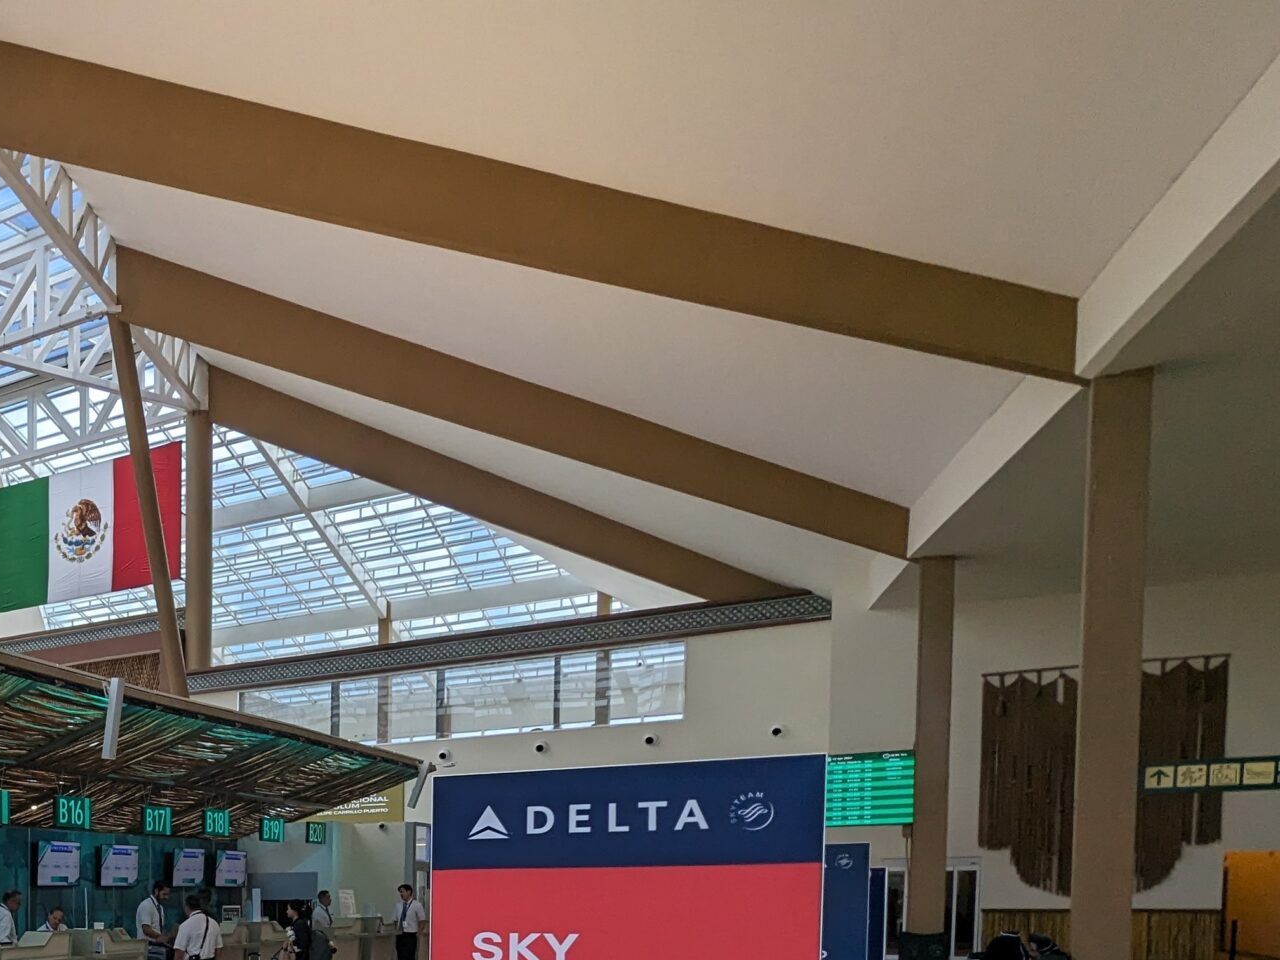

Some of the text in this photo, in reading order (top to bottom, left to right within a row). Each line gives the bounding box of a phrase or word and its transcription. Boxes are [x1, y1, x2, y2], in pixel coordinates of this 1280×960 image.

[59, 798, 83, 825] B16
[146, 808, 165, 832] B17
[206, 811, 224, 833] B18
[526, 799, 709, 835] DELTA
[263, 821, 279, 840] B19
[309, 823, 322, 842] B20
